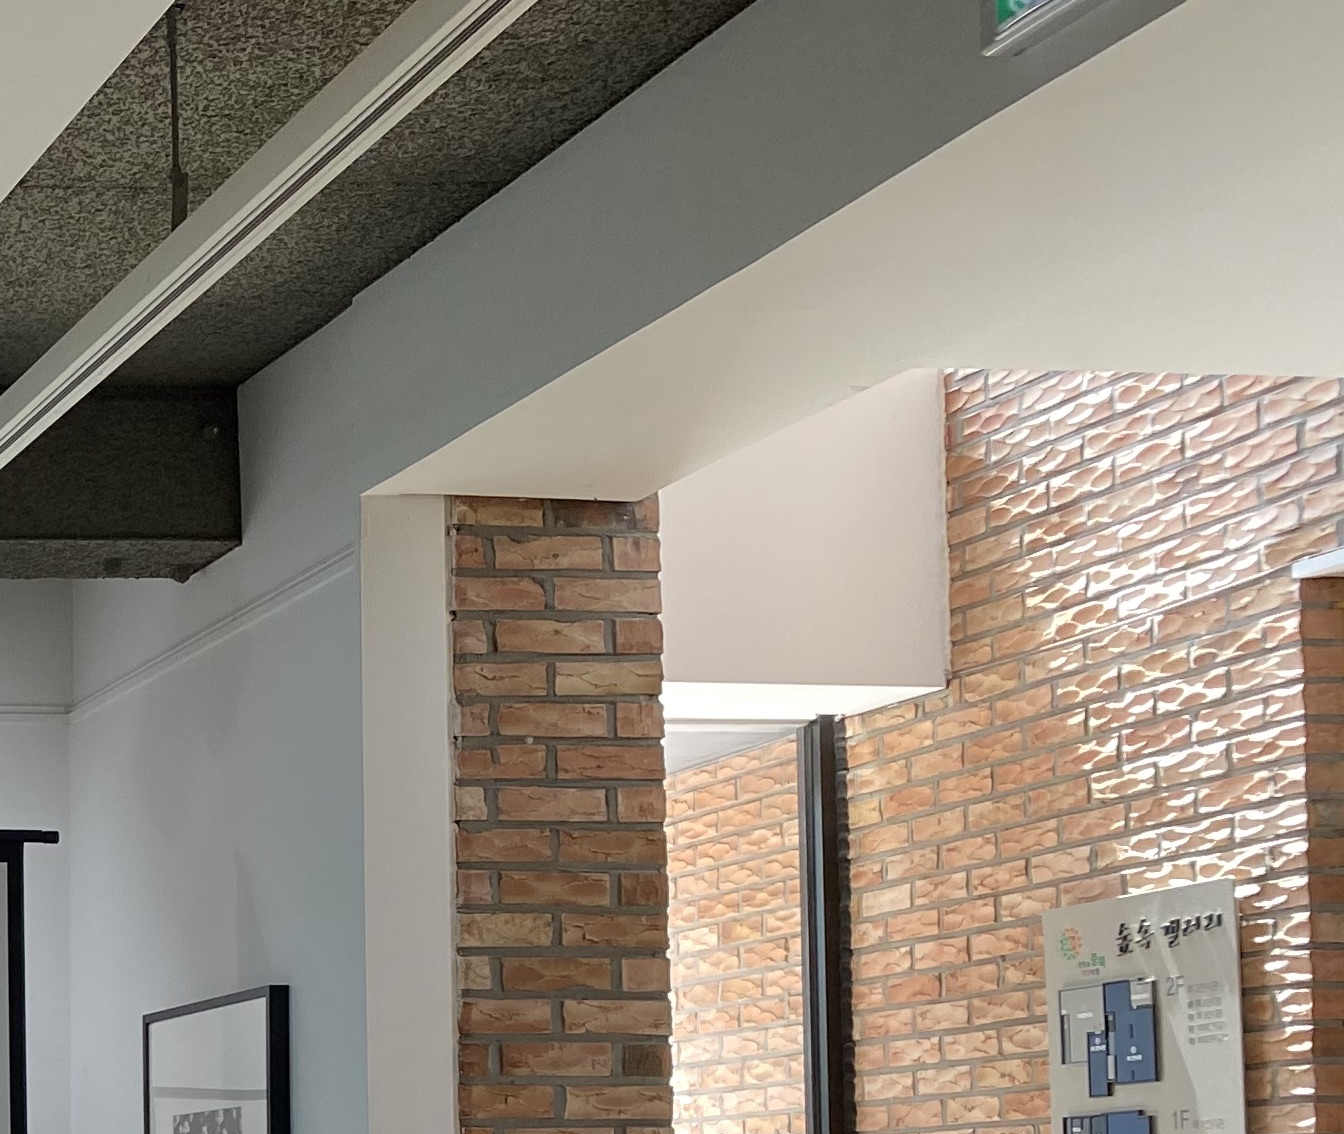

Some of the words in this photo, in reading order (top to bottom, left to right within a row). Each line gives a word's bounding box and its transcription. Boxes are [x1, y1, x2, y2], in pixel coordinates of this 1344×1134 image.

[1161, 913, 1223, 949] 갤러리
[1166, 975, 1184, 996] 2F
[1172, 1110, 1190, 1130] 1F
